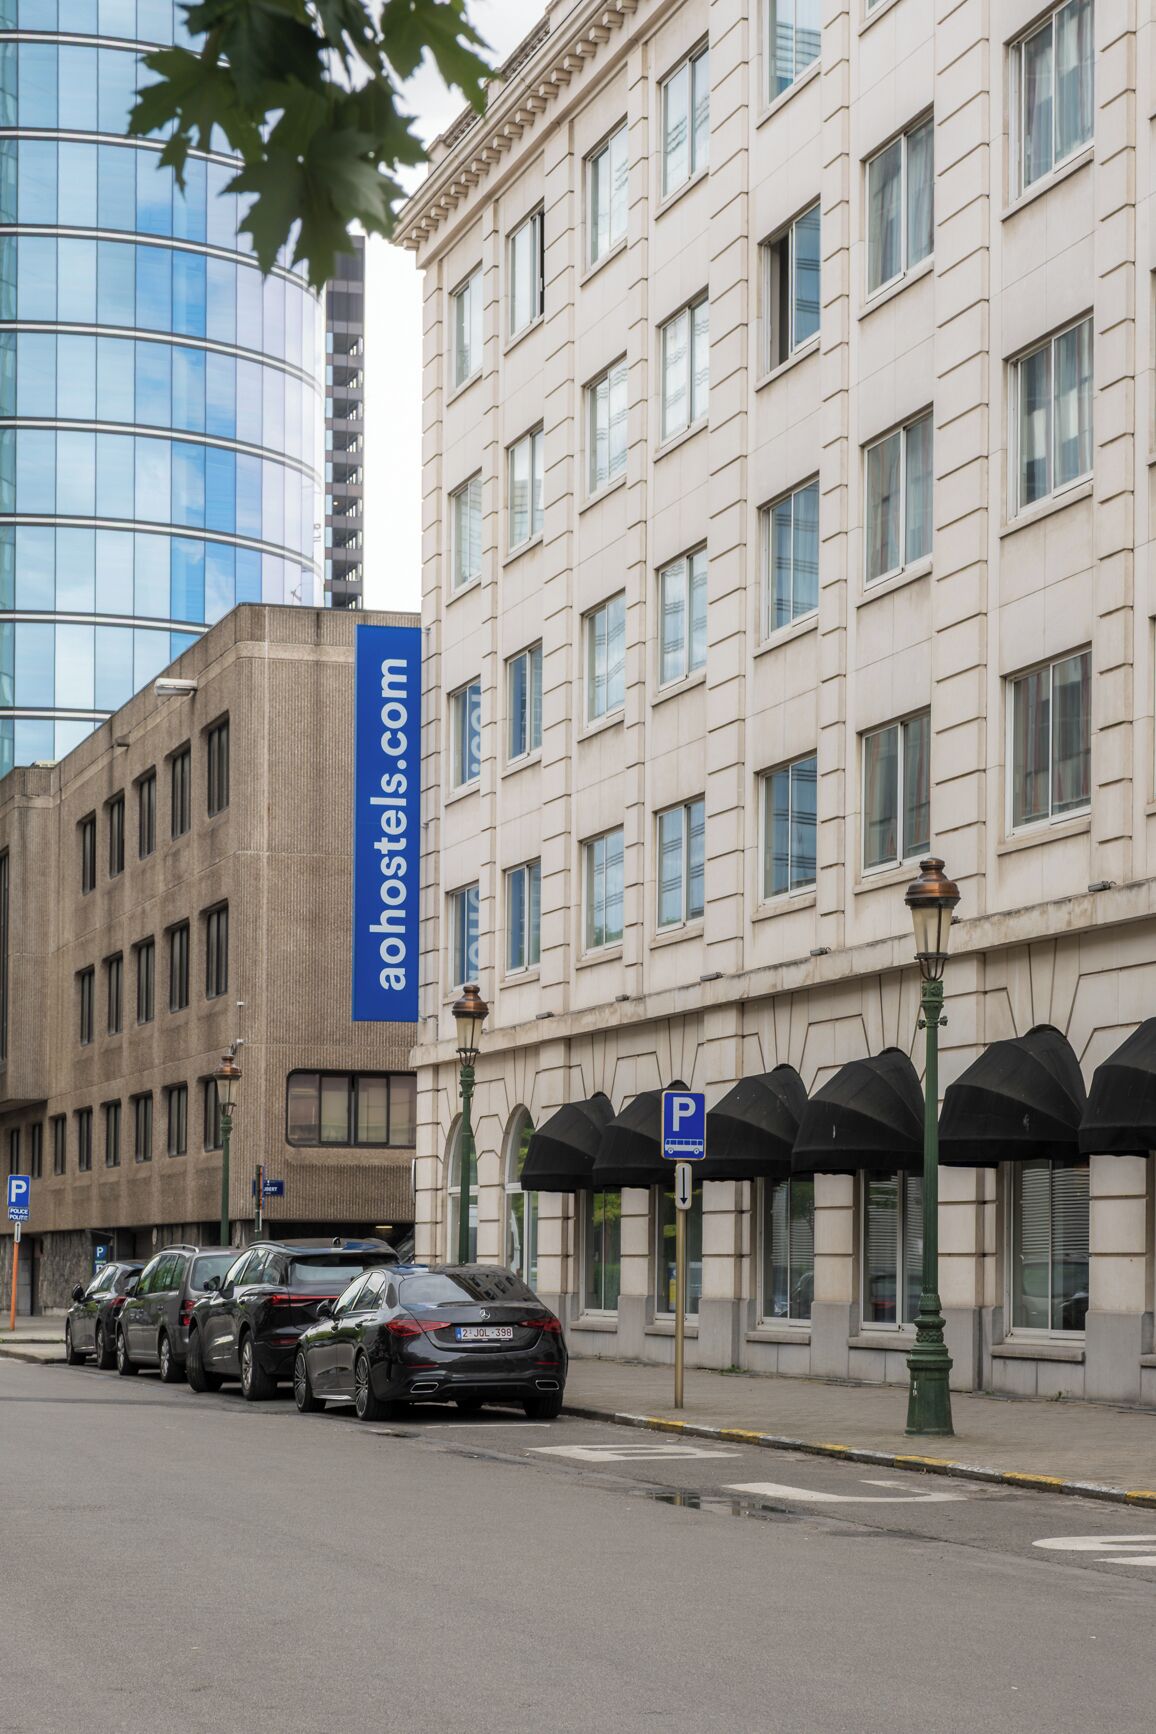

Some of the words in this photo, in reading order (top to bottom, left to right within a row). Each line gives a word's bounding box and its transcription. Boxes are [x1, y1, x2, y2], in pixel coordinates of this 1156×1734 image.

[369, 658, 408, 991] aohostels.com
[672, 1096, 697, 1132] P
[11, 1180, 27, 1202] P
[96, 1246, 104, 1257] P
